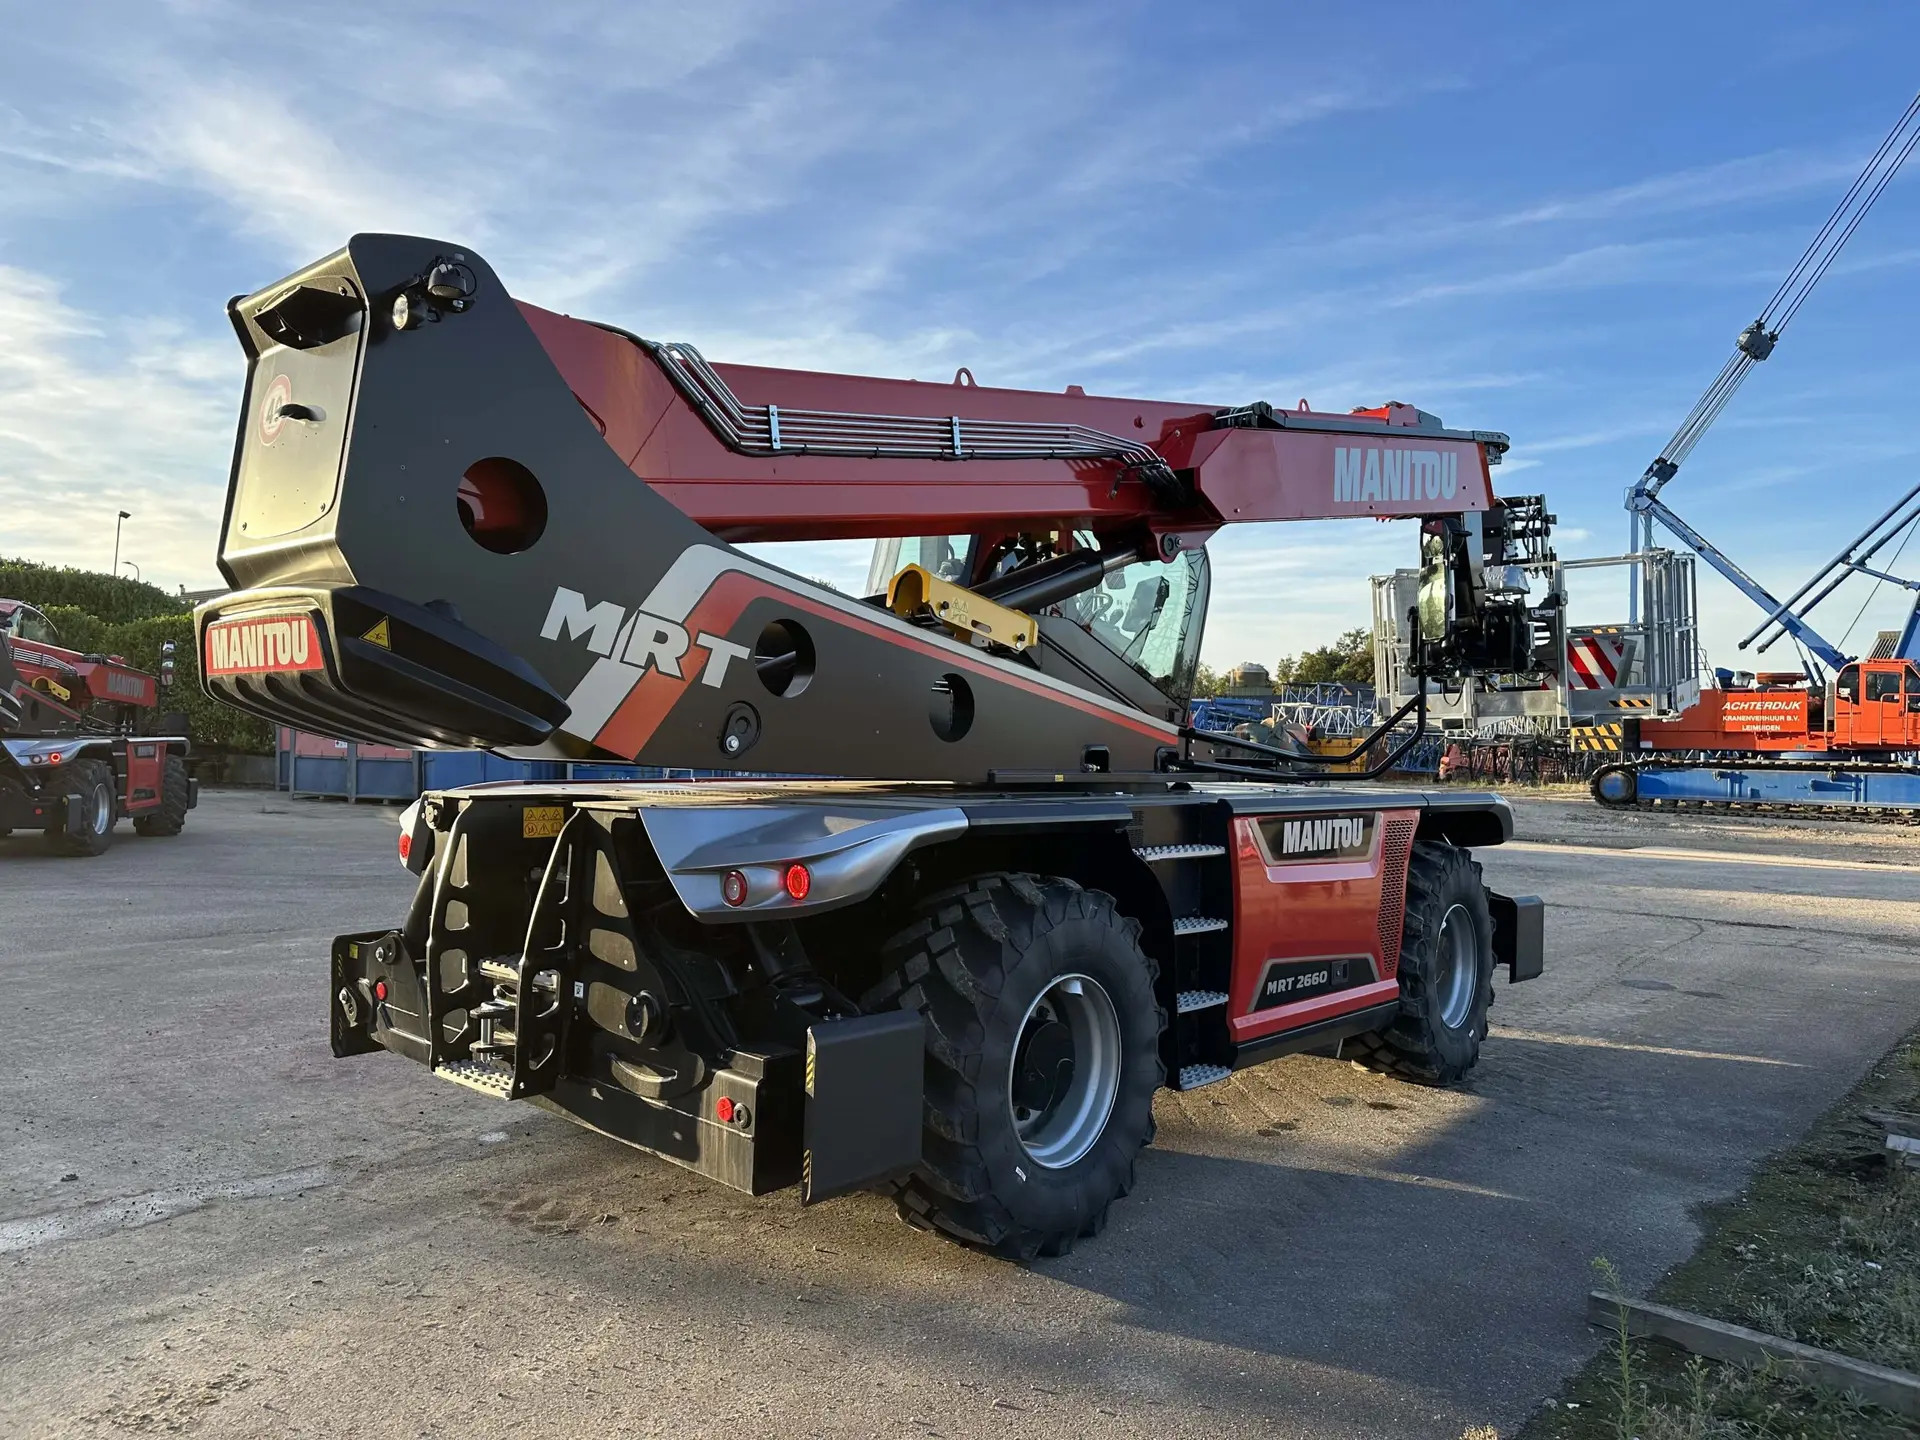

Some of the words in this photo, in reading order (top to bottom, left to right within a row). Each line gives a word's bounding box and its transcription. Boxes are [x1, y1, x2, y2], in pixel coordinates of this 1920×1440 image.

[1334, 447, 1457, 502] MANITOU
[211, 619, 308, 670] MANITOU
[540, 586, 750, 689] MRT
[1722, 701, 1802, 710] ACHTERDIJK
[1283, 818, 1363, 854] MANITOU
[1266, 978, 1294, 995] MRT
[1296, 970, 1328, 989] 2660
